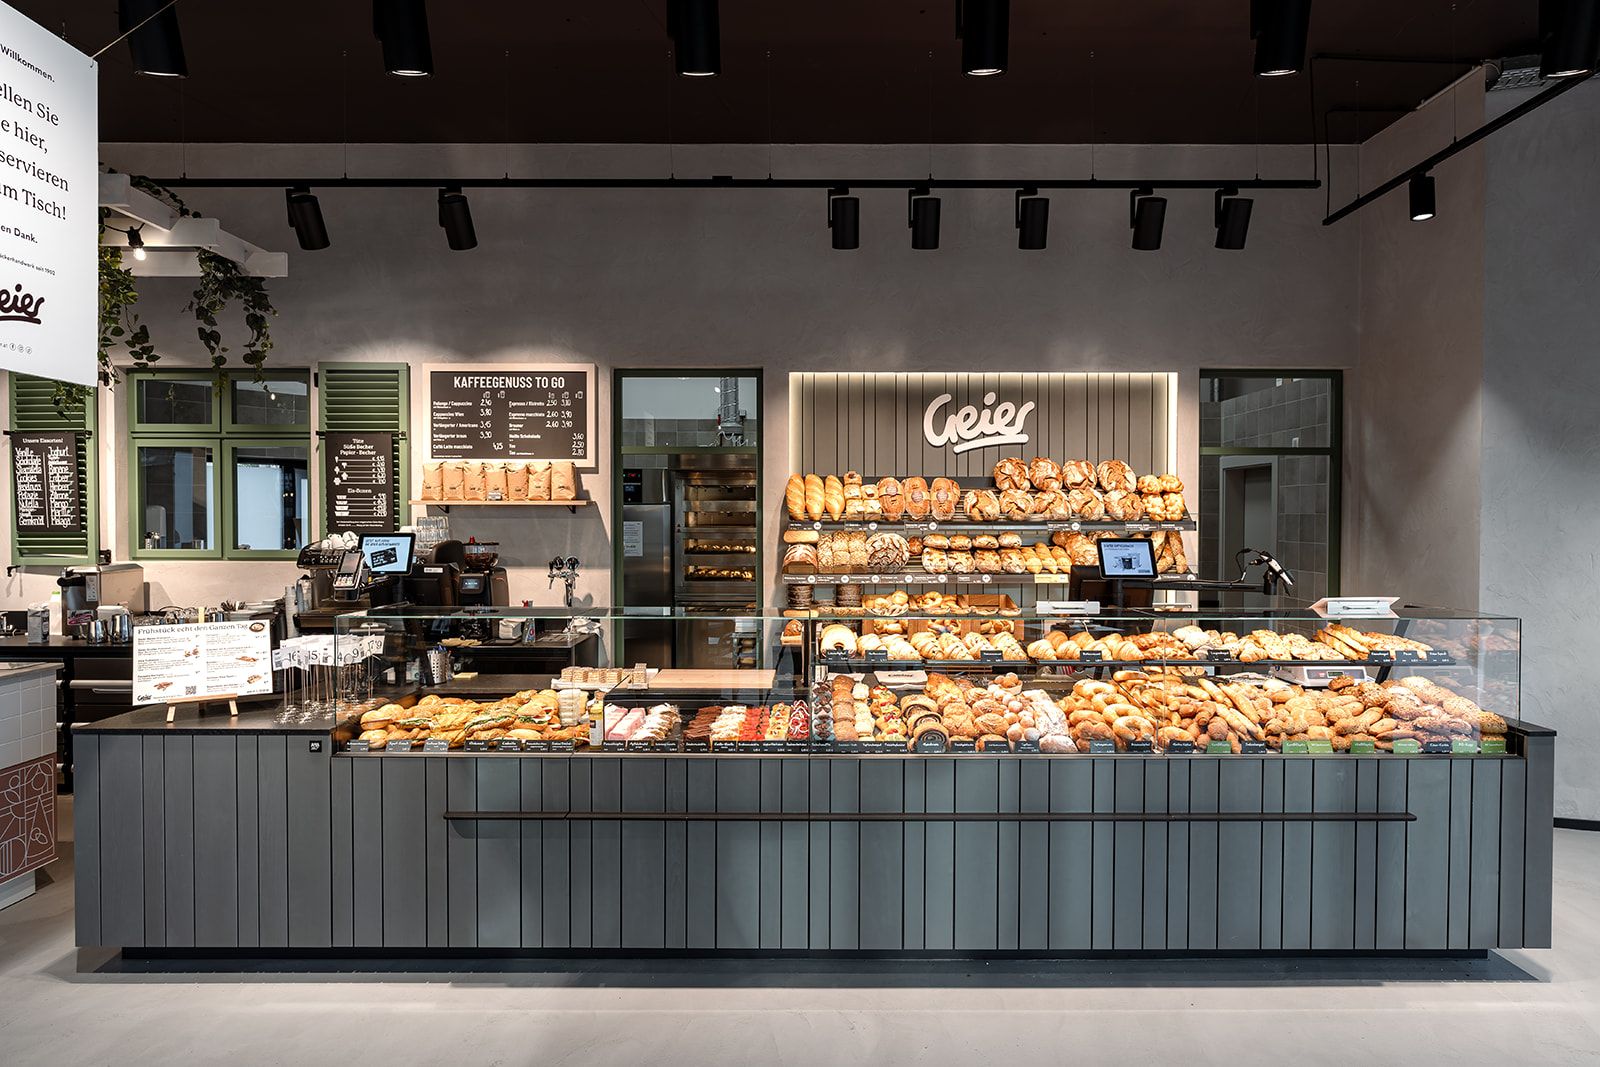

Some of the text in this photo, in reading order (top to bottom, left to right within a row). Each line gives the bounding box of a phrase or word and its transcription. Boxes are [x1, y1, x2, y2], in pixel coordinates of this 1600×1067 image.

[0, 44, 55, 83] Willkommen.
[36, 102, 59, 126] Sie
[14, 121, 48, 154] hier,
[0, 150, 69, 192] servieren
[0, 184, 66, 220] m Tisch!
[1, 225, 38, 244] en Dank.
[454, 376, 565, 388] KAFFEEGENUSS TO GO
[923, 392, 1035, 454] Geier
[137, 627, 175, 635] Frühstück
